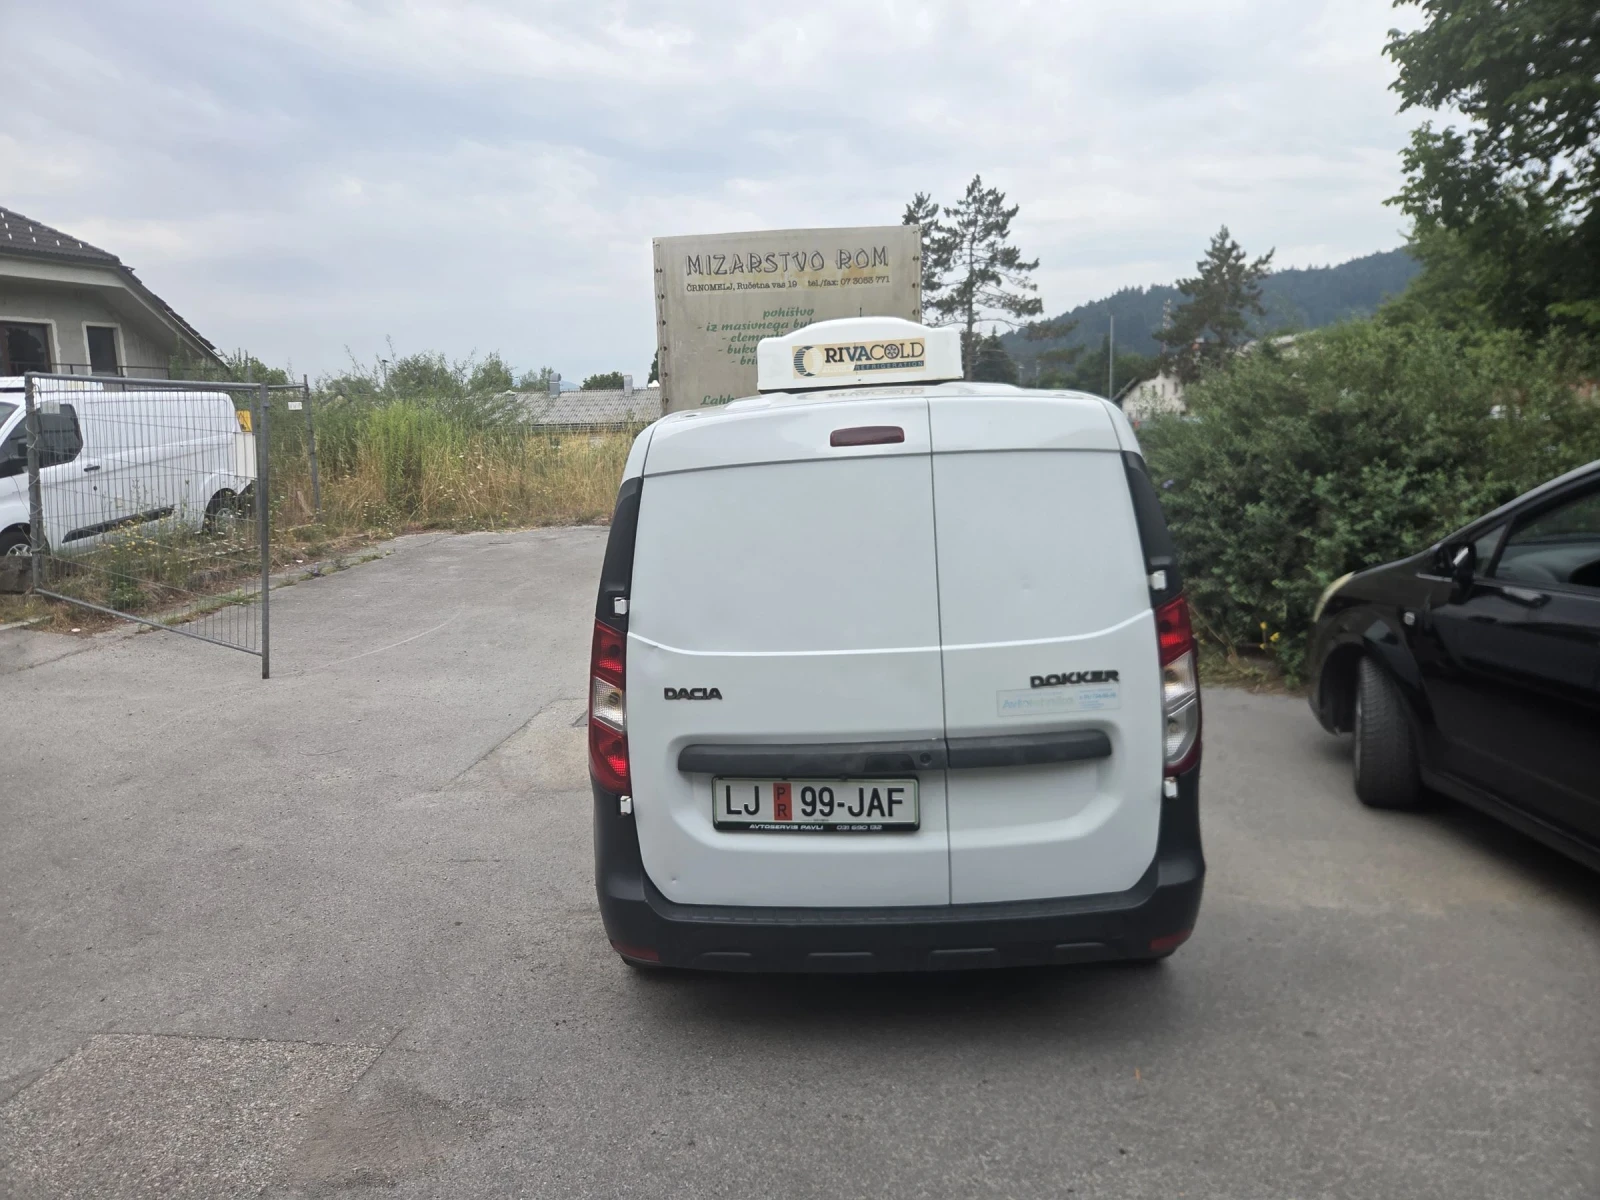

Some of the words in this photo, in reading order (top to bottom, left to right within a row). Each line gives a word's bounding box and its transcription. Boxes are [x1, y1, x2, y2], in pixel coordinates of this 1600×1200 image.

[686, 251, 824, 276] MIZARSTVO
[835, 246, 889, 270] ROM
[686, 282, 735, 292] ČRNOMELJ,
[788, 280, 798, 288] 19
[840, 277, 851, 286] 07
[763, 307, 815, 320] pohištvo
[706, 322, 717, 332] iz
[721, 319, 789, 331] masivnega
[824, 342, 925, 363] RIVACOLD
[856, 361, 923, 370] REFRIGERATION
[1030, 669, 1119, 689] DOKKER
[664, 687, 722, 700] DACIA
[726, 785, 760, 815] LJ
[801, 786, 904, 817] 99-JAF
